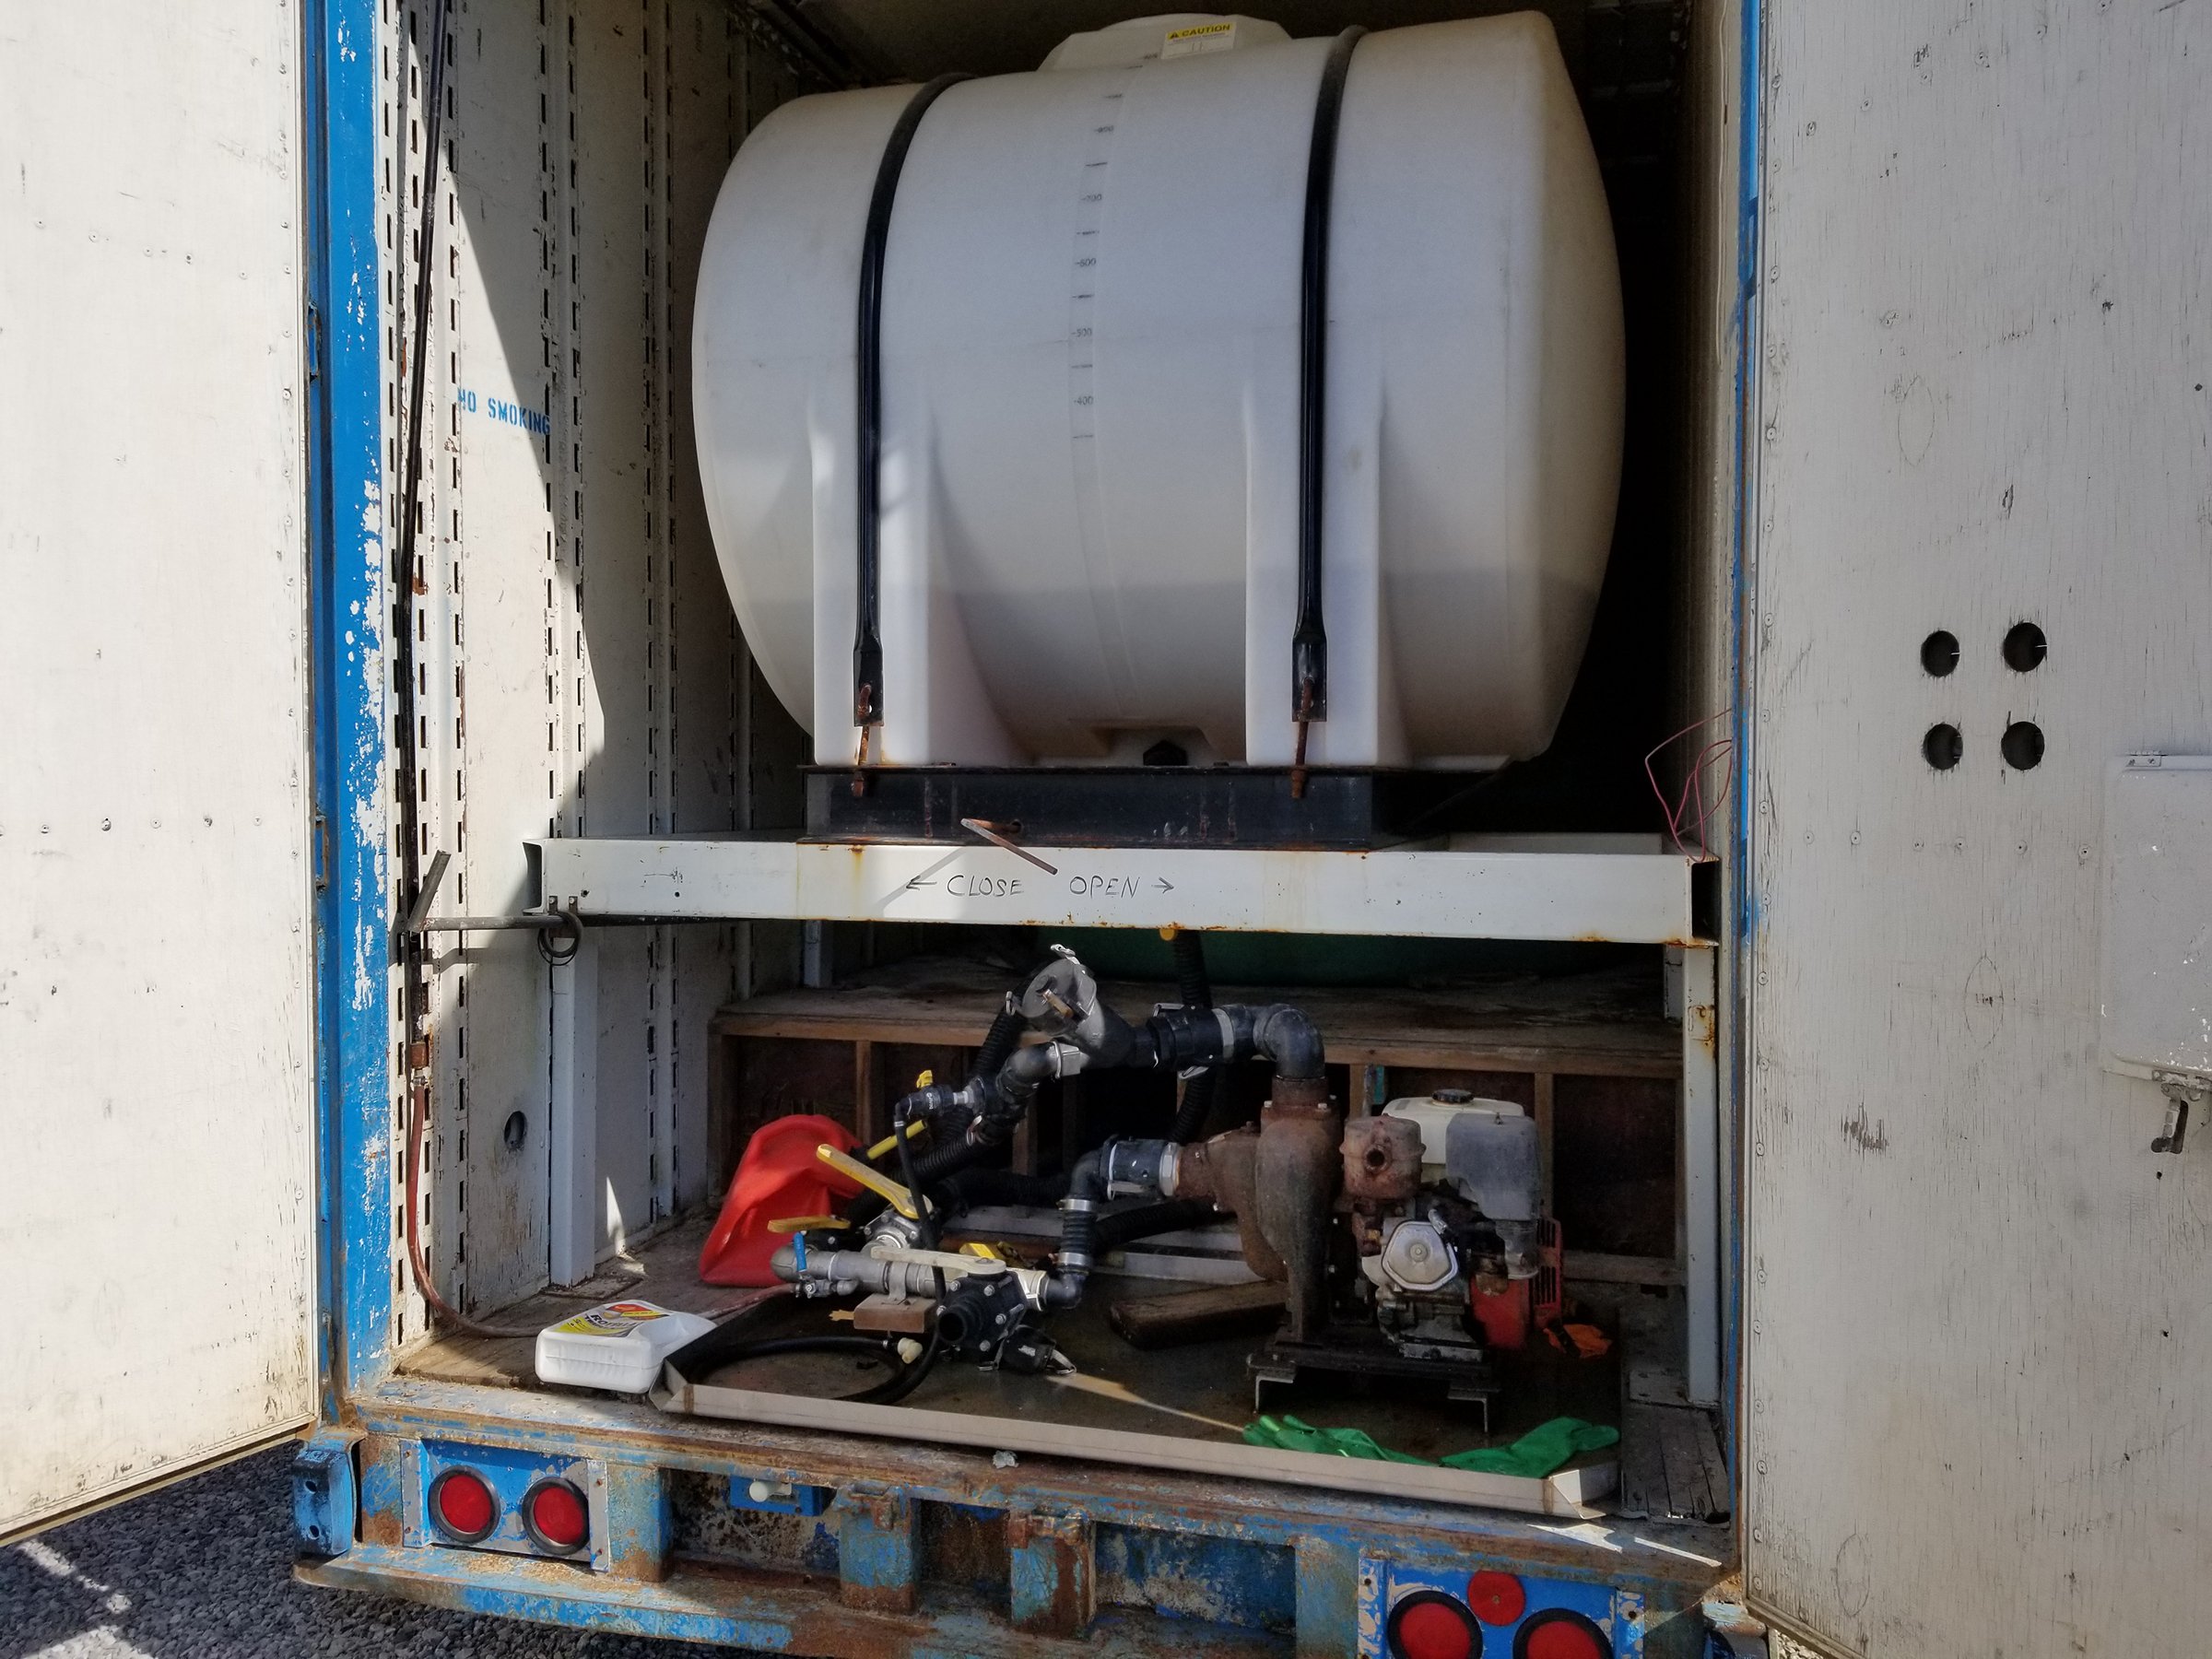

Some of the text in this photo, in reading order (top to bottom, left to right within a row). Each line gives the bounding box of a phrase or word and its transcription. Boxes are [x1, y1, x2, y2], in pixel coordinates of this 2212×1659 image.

[1182, 24, 1230, 37] CAUTION
[457, 387, 550, 436] NO SMOKING
[947, 875, 1141, 899] CLOSE OPEN
